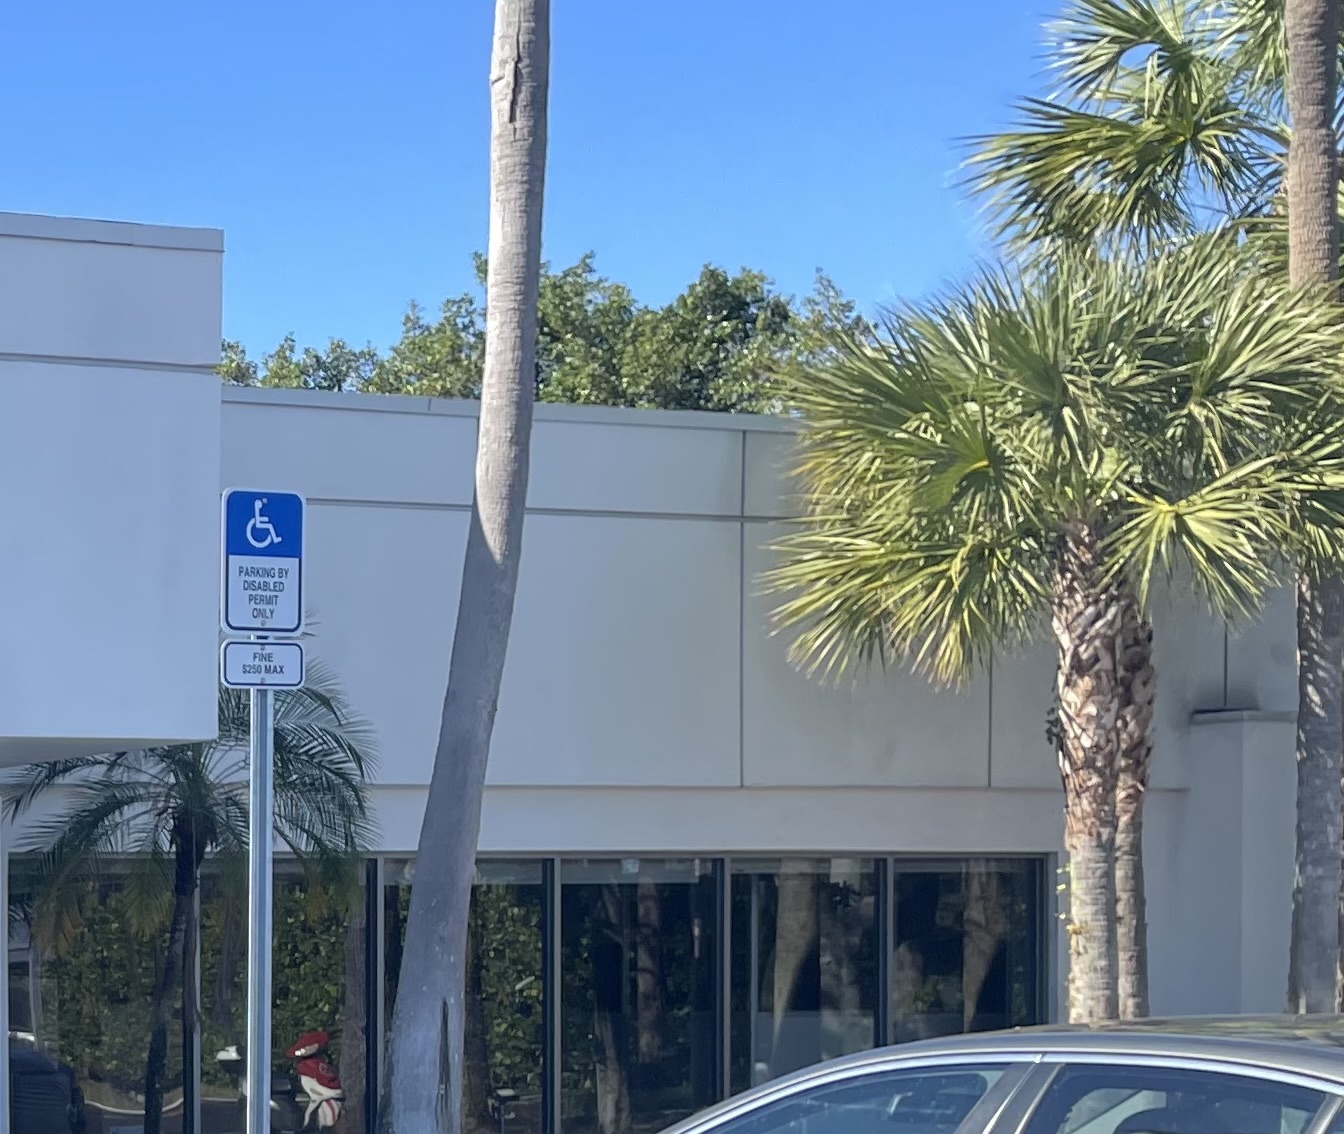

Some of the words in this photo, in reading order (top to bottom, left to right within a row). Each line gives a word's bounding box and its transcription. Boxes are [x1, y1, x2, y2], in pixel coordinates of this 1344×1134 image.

[238, 565, 276, 579] PARKING
[277, 567, 290, 579] BY
[242, 579, 285, 593] DISABLED
[248, 593, 279, 606] PERMIT
[251, 607, 275, 620] ONLY
[252, 651, 274, 663] FINE
[242, 663, 263, 675] $250
[263, 664, 285, 675] MAX
